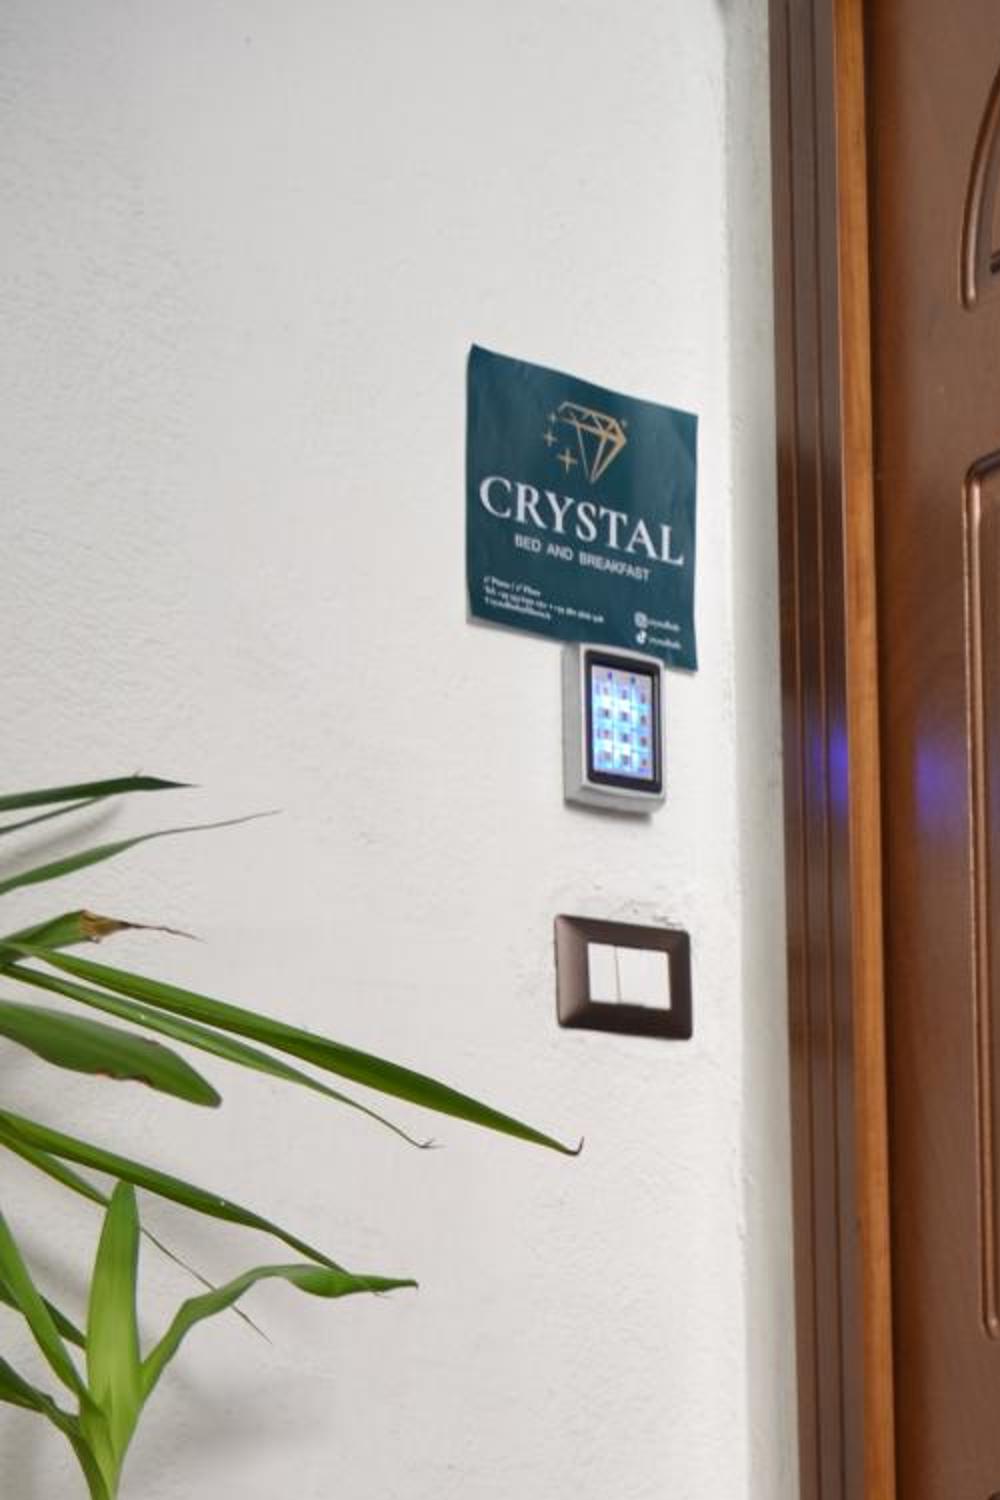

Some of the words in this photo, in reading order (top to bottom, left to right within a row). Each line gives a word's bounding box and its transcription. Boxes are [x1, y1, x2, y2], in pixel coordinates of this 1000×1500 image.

[479, 476, 684, 565] CRYSTAL
[514, 534, 541, 552] BED
[547, 543, 574, 561] AND
[579, 551, 651, 581] BREAKFAST
